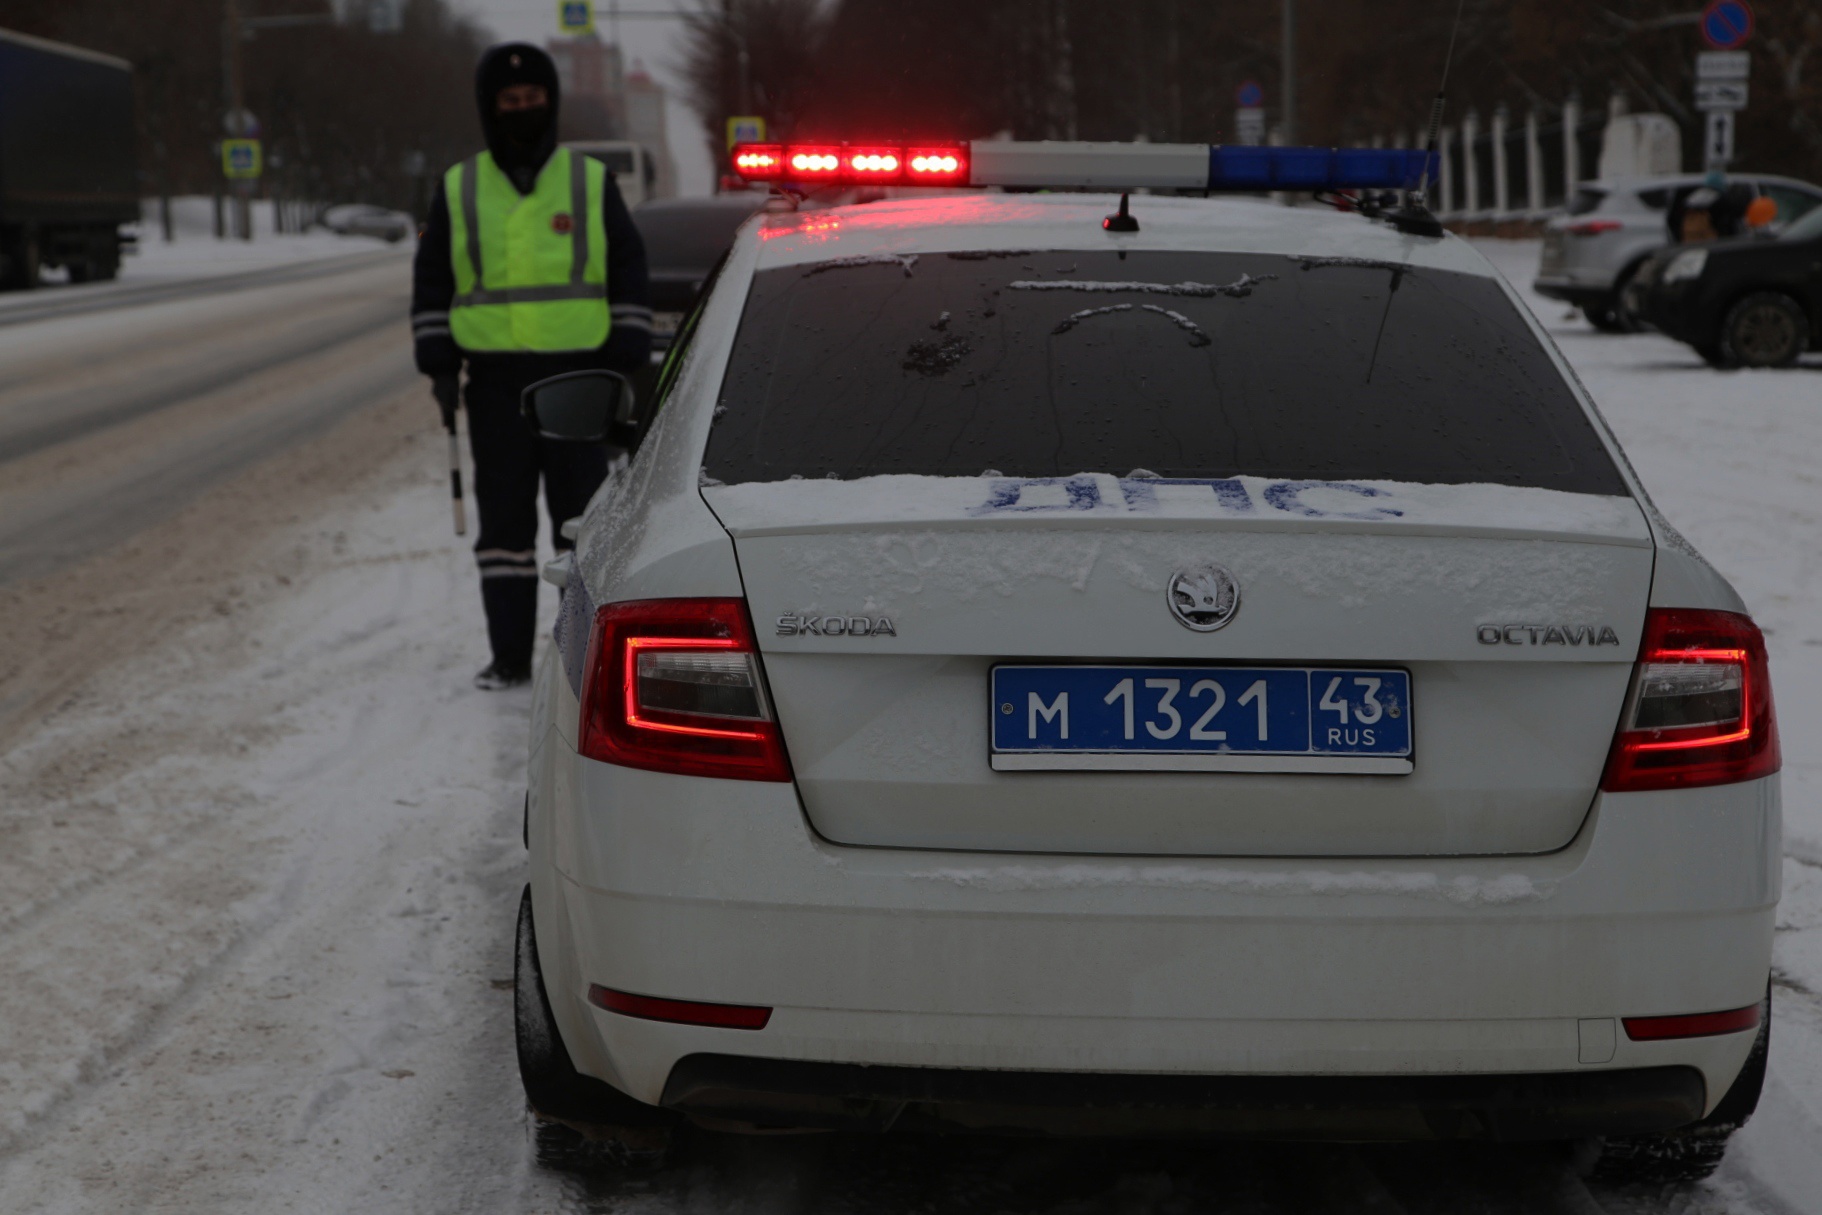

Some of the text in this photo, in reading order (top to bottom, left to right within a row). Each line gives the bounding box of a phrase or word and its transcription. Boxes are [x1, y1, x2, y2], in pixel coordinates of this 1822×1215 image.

[966, 477, 1404, 519] ДПС
[776, 611, 897, 637] ŠKODA
[1477, 624, 1620, 646] OCTAVIA
[1103, 678, 1268, 741] 1321
[1319, 676, 1383, 725] 43
[1328, 728, 1376, 746] RUS
